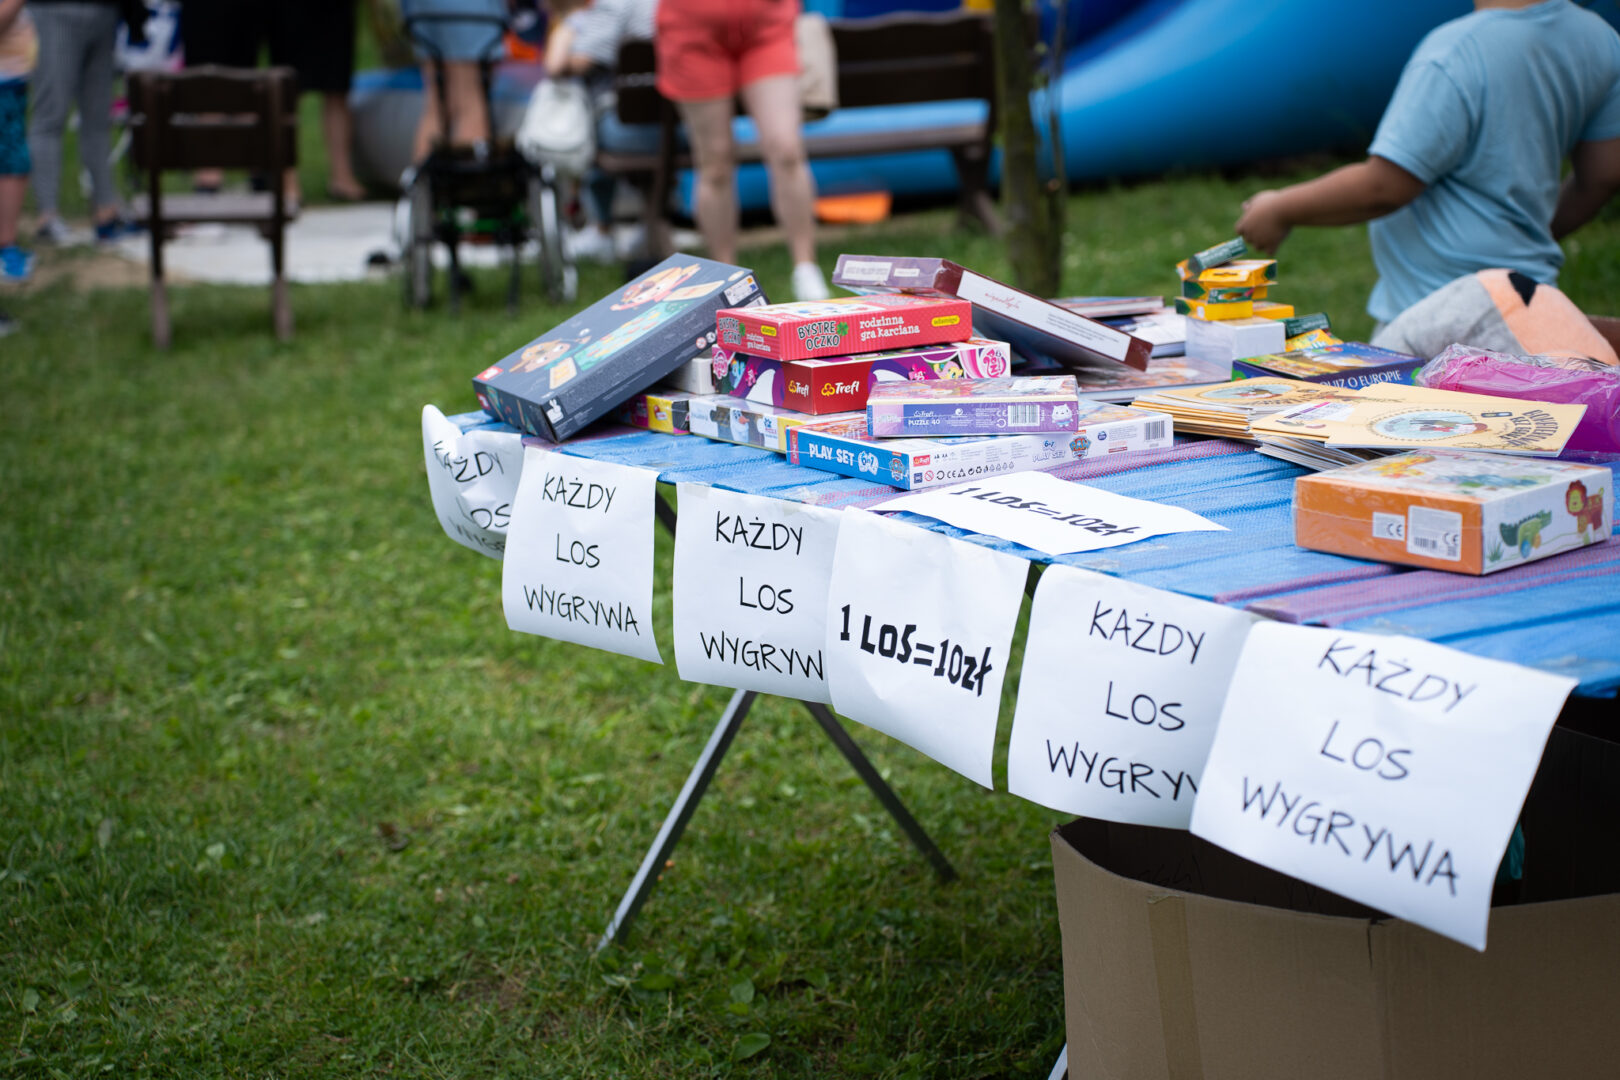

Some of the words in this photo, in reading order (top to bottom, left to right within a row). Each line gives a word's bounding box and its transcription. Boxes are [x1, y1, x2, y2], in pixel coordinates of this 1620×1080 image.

[797, 321, 837, 340] BYSTRE
[859, 315, 904, 330] rodzinna
[861, 328, 877, 342] gra
[878, 323, 920, 338] karciana
[806, 334, 840, 351] OCZKO
[796, 382, 809, 397] Trefl
[835, 381, 860, 395] Trefl
[1347, 375, 1358, 388] O
[1359, 369, 1403, 388] EUROPIE
[809, 443, 833, 460] PLAY
[836, 448, 855, 467] SET
[542, 472, 617, 514] KAŻDY
[556, 533, 601, 569] LOS
[715, 510, 803, 556] KAŻDY
[523, 584, 640, 636] WYGRYWA
[739, 576, 794, 615] LOS
[840, 604, 851, 642] 1
[1089, 600, 1206, 665] KAŻDY
[700, 631, 824, 681] WYGRYW
[1318, 637, 1478, 713] KAŻDY
[1105, 681, 1185, 731] LOS
[1046, 739, 1198, 801] WYGRY
[1320, 720, 1414, 781] LOS
[1242, 776, 1460, 897] WYGRYWA
